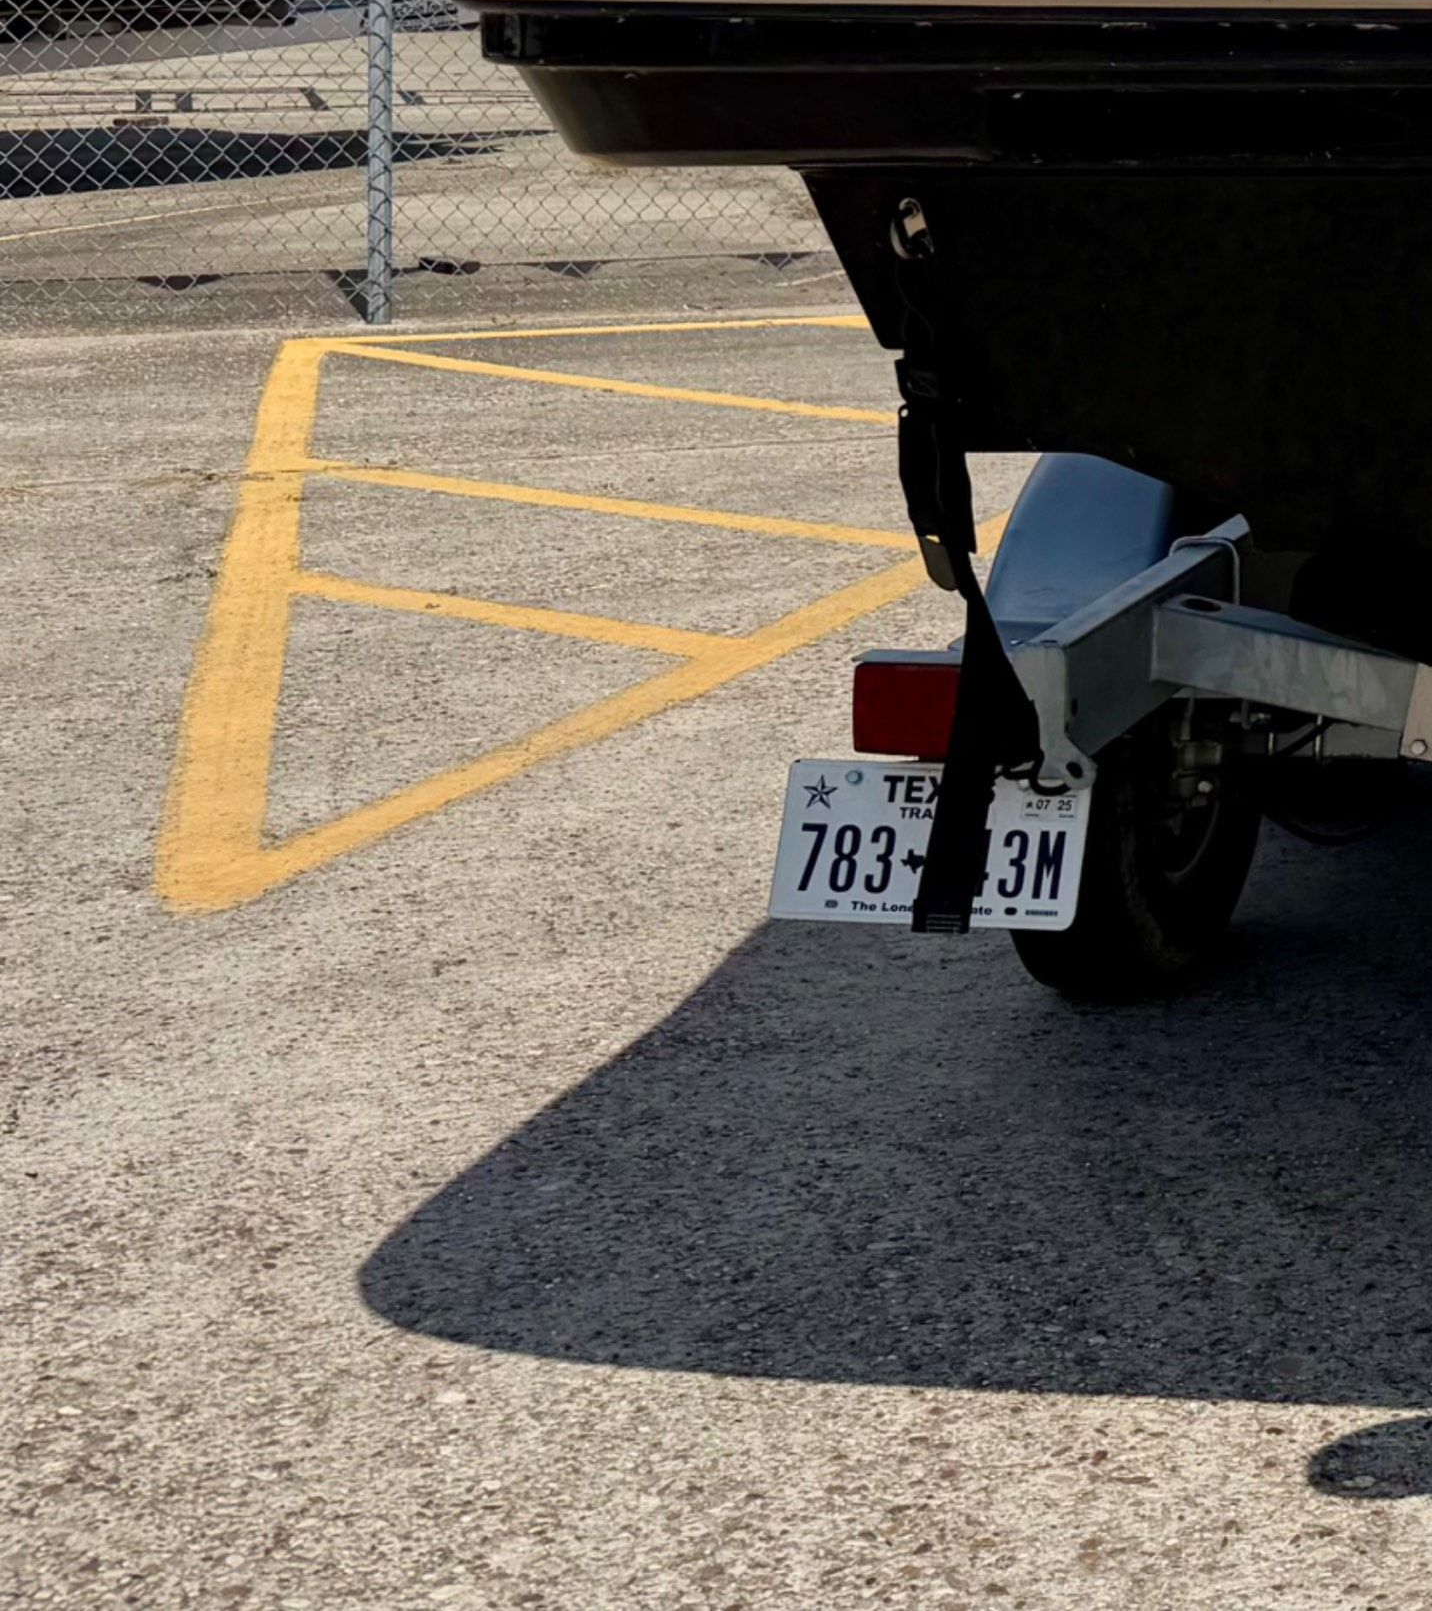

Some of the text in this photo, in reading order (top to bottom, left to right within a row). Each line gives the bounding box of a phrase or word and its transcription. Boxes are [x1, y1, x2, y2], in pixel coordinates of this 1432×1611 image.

[883, 775, 944, 804] TEX
[1036, 798, 1072, 811] 07 25
[797, 822, 897, 894] 783
[851, 900, 877, 912] The
